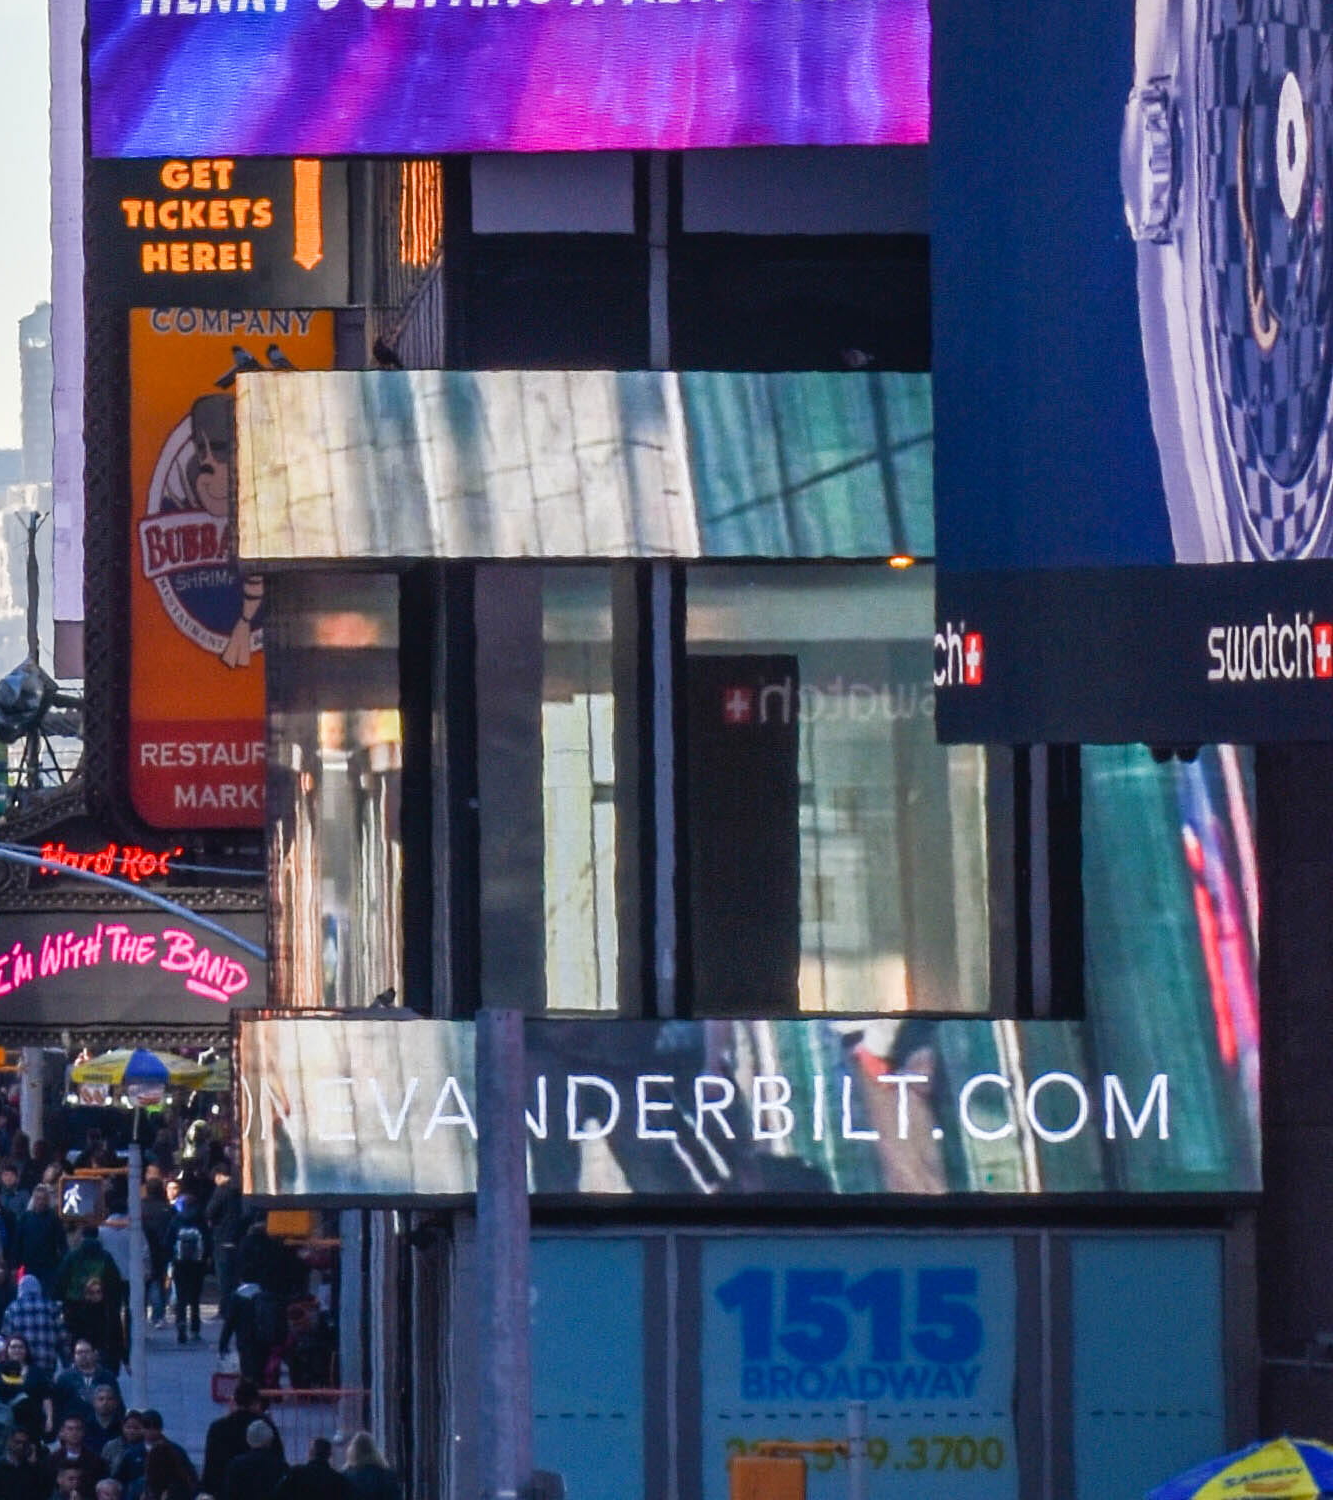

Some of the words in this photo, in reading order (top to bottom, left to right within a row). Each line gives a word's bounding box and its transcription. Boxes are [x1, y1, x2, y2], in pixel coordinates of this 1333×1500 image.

[160, 160, 235, 190] GET
[121, 198, 274, 230] TICKETS
[141, 241, 254, 273] HERE!
[151, 308, 315, 336] COMPANY
[1208, 612, 1314, 681] swatch
[174, 783, 265, 810] MARK
[40, 843, 117, 875] Hard
[39, 923, 103, 977] WITH
[104, 923, 156, 966] THE
[159, 929, 250, 998] BAND
[716, 1268, 985, 1364] 1515
[741, 1365, 982, 1401] BROADWAY
